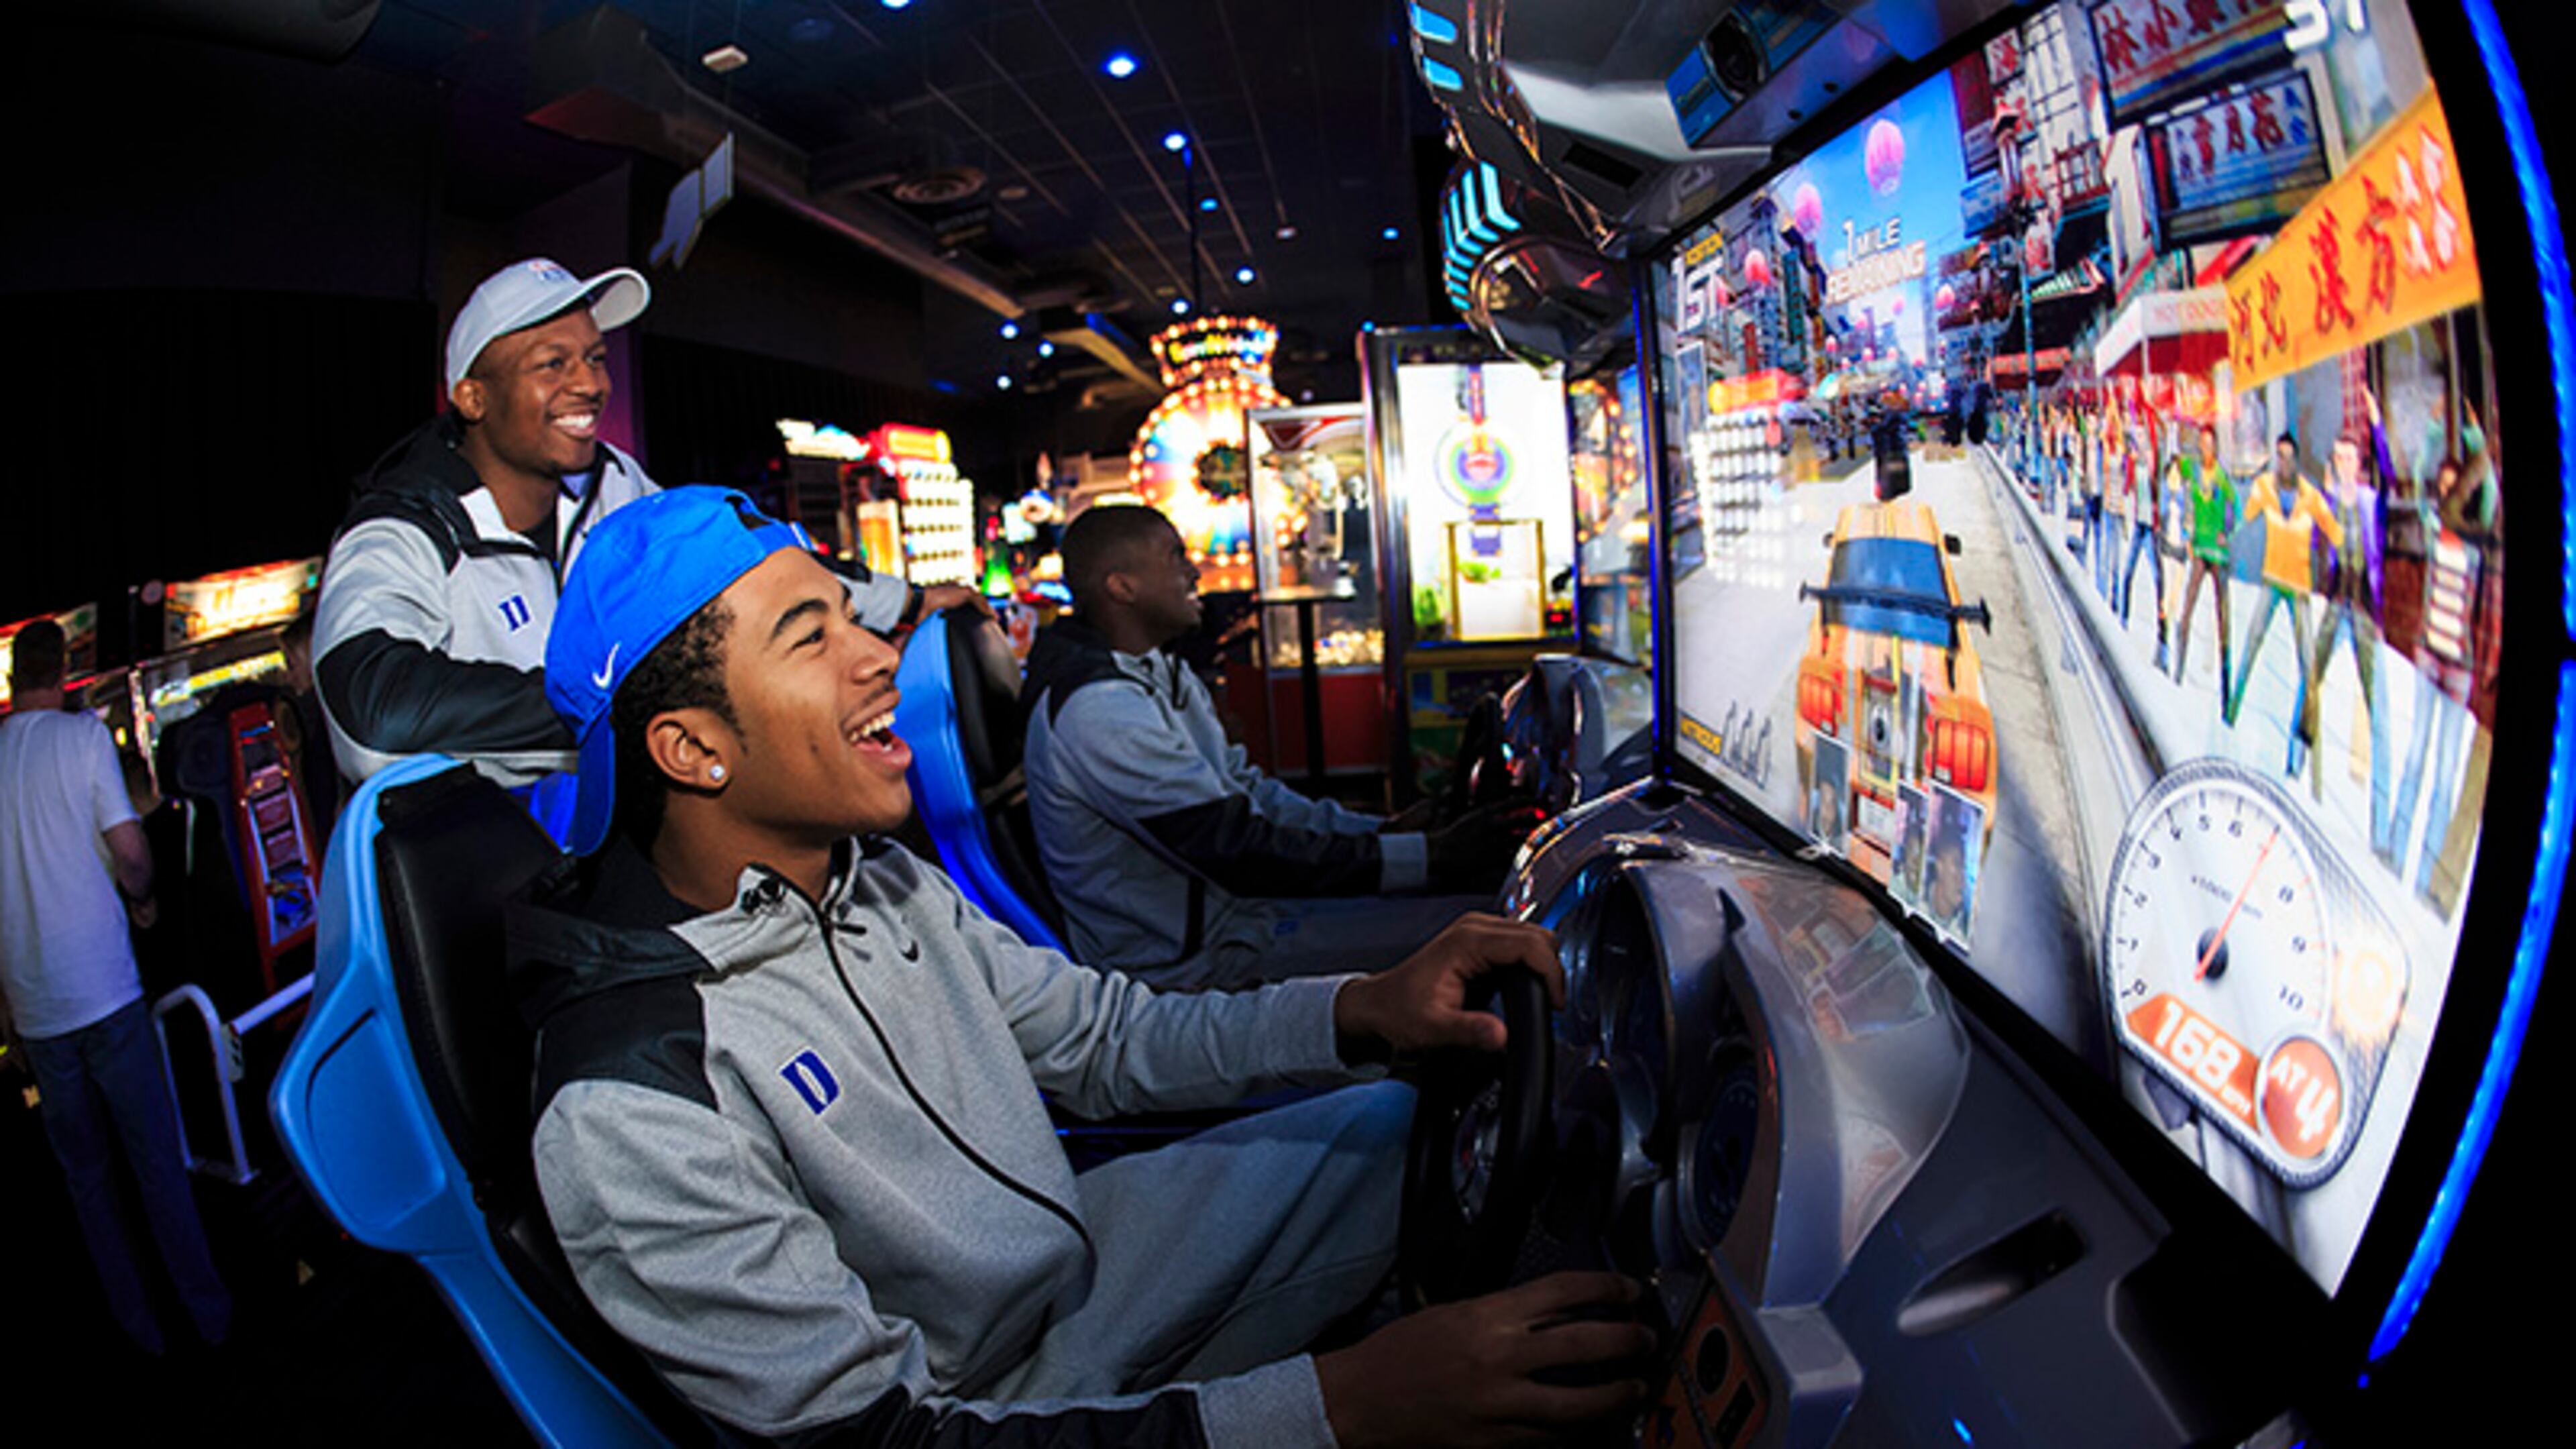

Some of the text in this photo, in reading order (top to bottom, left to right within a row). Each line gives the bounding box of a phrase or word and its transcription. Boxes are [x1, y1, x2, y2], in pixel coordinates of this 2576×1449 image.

[2154, 1000, 2241, 1090] 168
[778, 1049, 841, 1116] D
[2296, 1076, 2336, 1142] 4
